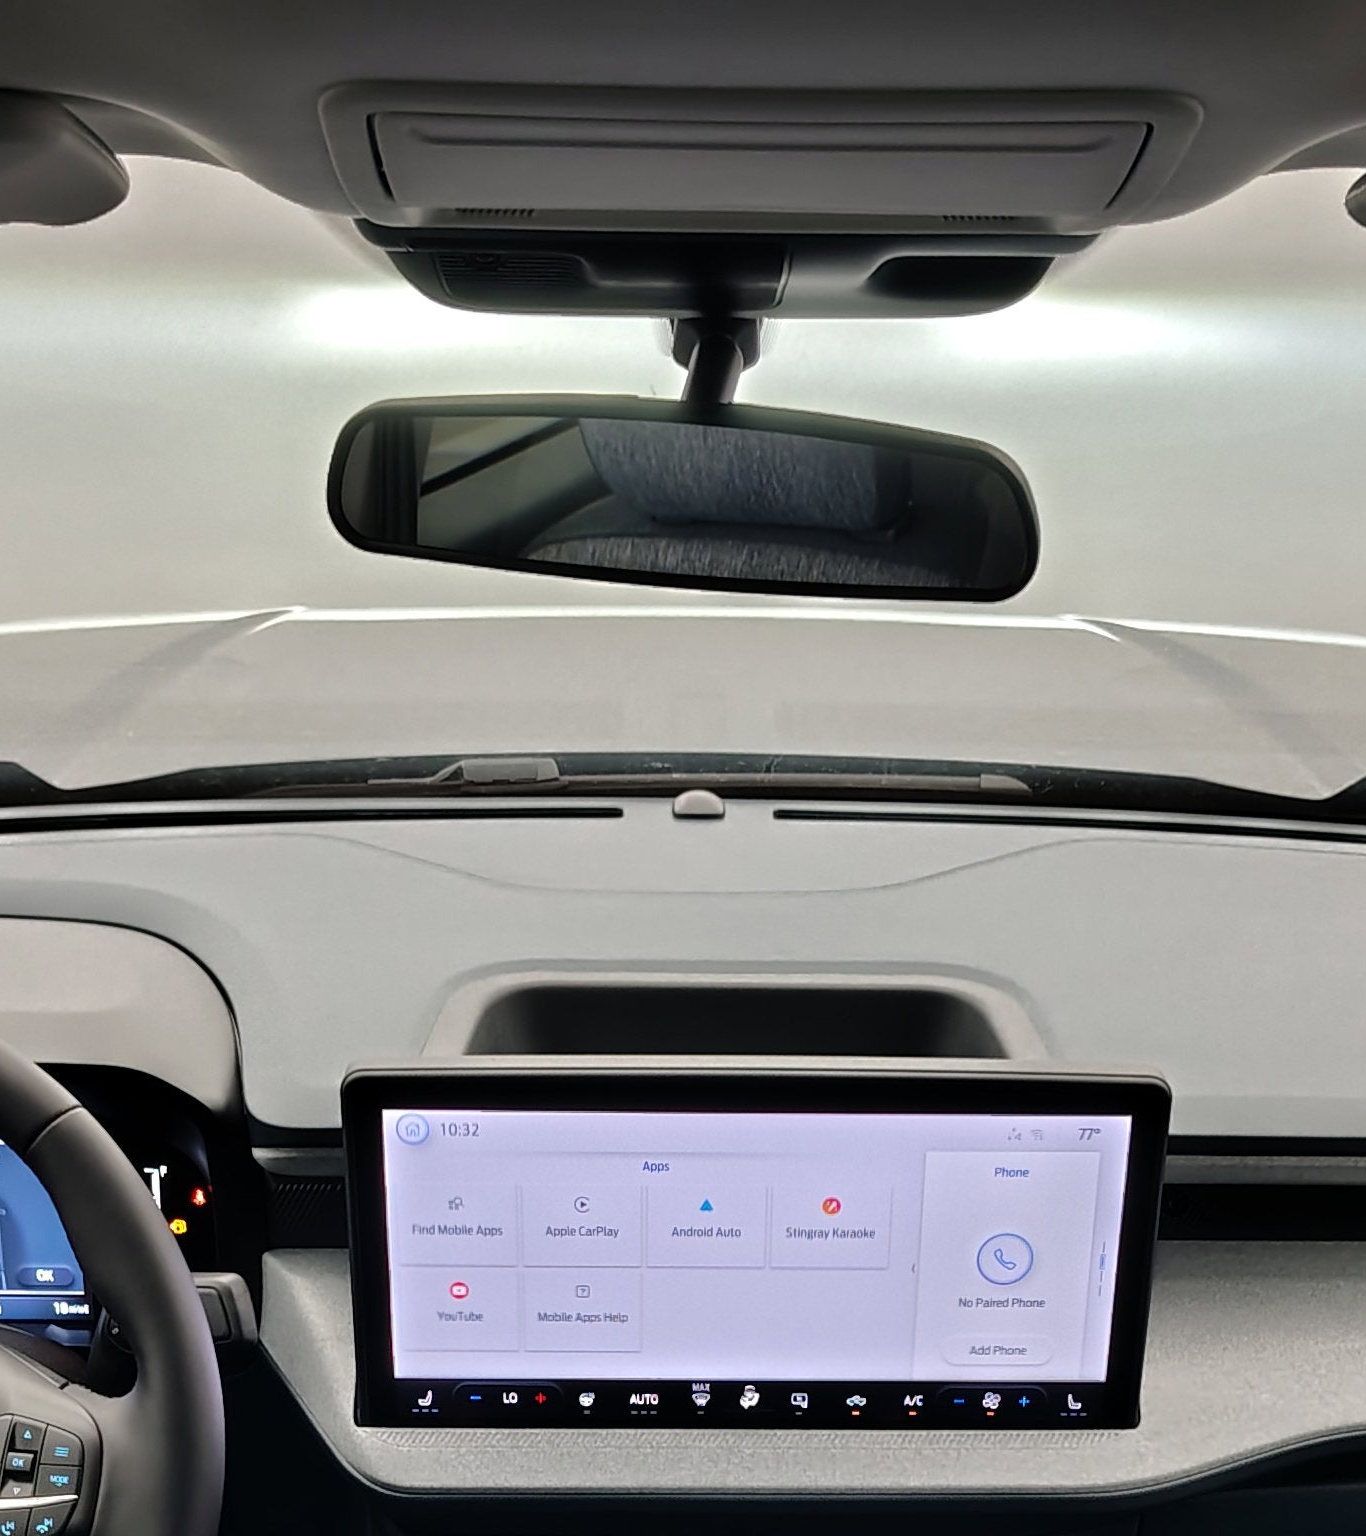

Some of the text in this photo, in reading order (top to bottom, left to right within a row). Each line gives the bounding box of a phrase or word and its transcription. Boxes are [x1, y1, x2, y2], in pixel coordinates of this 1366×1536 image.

[440, 1122, 480, 1137] 10:32
[642, 1161, 670, 1173] Apps
[994, 1167, 1030, 1178] Phone
[411, 1224, 503, 1237] Find Mobile Apps
[546, 1226, 619, 1239] Apple CarPlay
[671, 1226, 742, 1238] Android Auto
[785, 1226, 876, 1240] Stingray Karaoke
[958, 1298, 1045, 1308] No Paired Phone
[437, 1311, 483, 1322] YouTube
[537, 1312, 629, 1324] Mobile Apps Help
[969, 1345, 1027, 1356] Add Phone
[692, 1383, 710, 1392] MAX
[502, 1392, 518, 1404] LO
[629, 1393, 659, 1405] AUTO
[903, 1395, 924, 1406] A/C
[12, 1458, 24, 1468] OK
[50, 1475, 69, 1484] MODE
